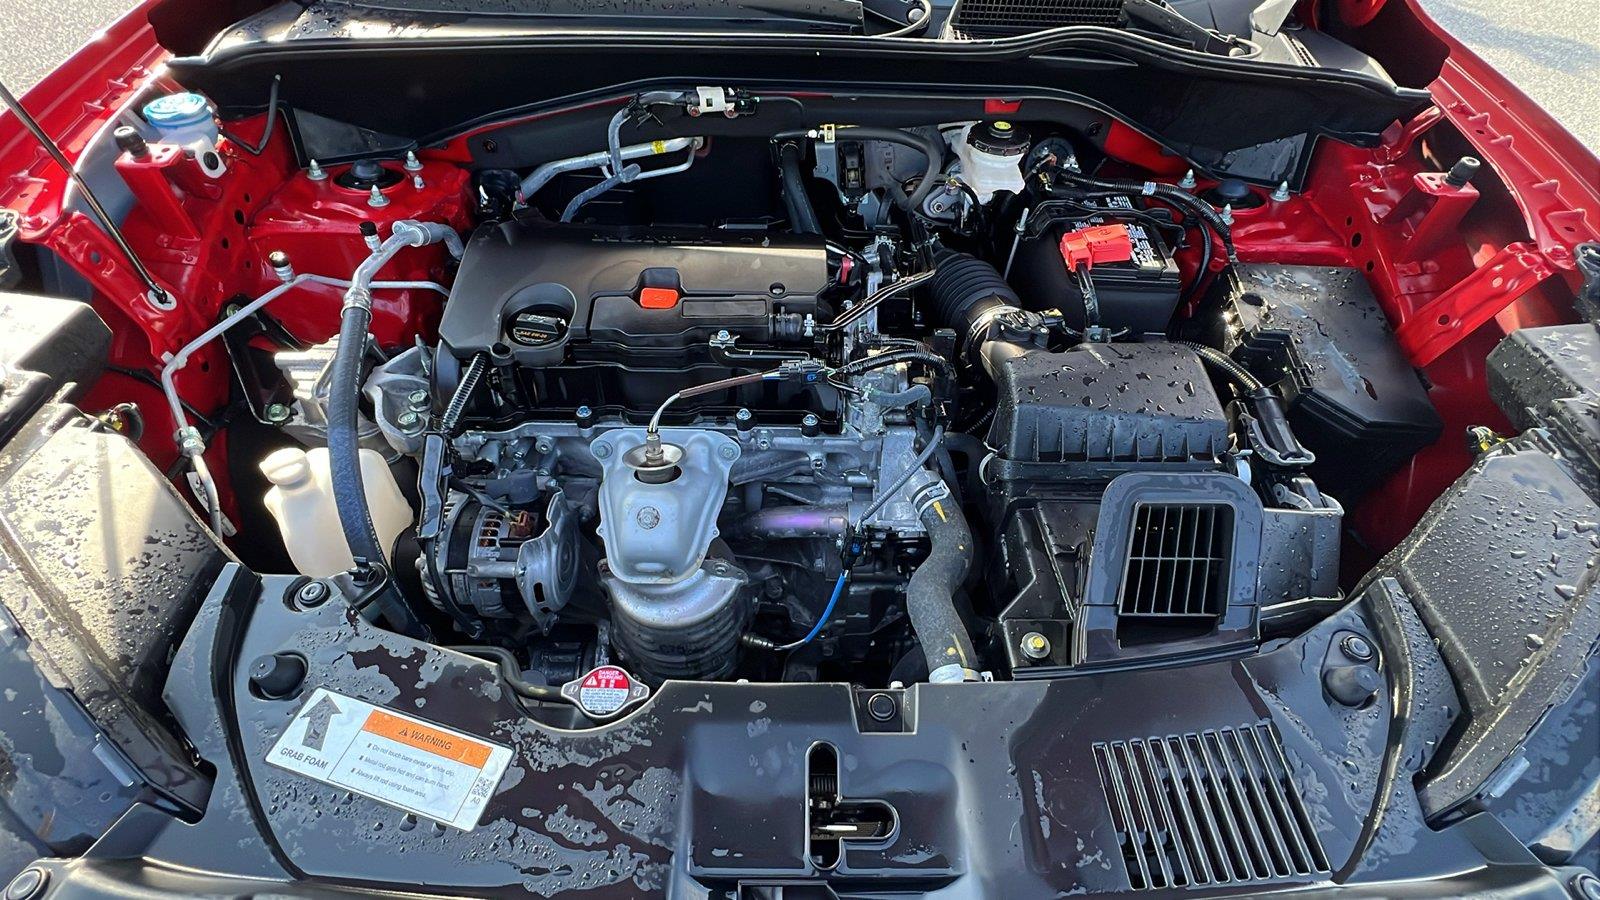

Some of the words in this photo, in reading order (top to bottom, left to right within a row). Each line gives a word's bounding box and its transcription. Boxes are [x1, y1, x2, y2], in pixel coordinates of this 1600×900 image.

[410, 730, 453, 750] WARNING
[280, 747, 304, 761] GRAB
[302, 755, 329, 770] FOAM
[364, 756, 379, 766] Metal
[377, 761, 387, 769] rod
[385, 764, 397, 772] gets
[396, 767, 406, 776] hot
[404, 771, 416, 779] and
[424, 777, 437, 786] burn
[372, 744, 380, 752] Do
[387, 750, 402, 759] touch
[401, 755, 413, 763] bare
[412, 758, 428, 767] metal
[432, 764, 446, 773] white
[355, 769, 374, 780] Always
[373, 774, 381, 782] lift
[379, 777, 389, 785] rod
[388, 781, 403, 791] using
[401, 784, 416, 794] foam
